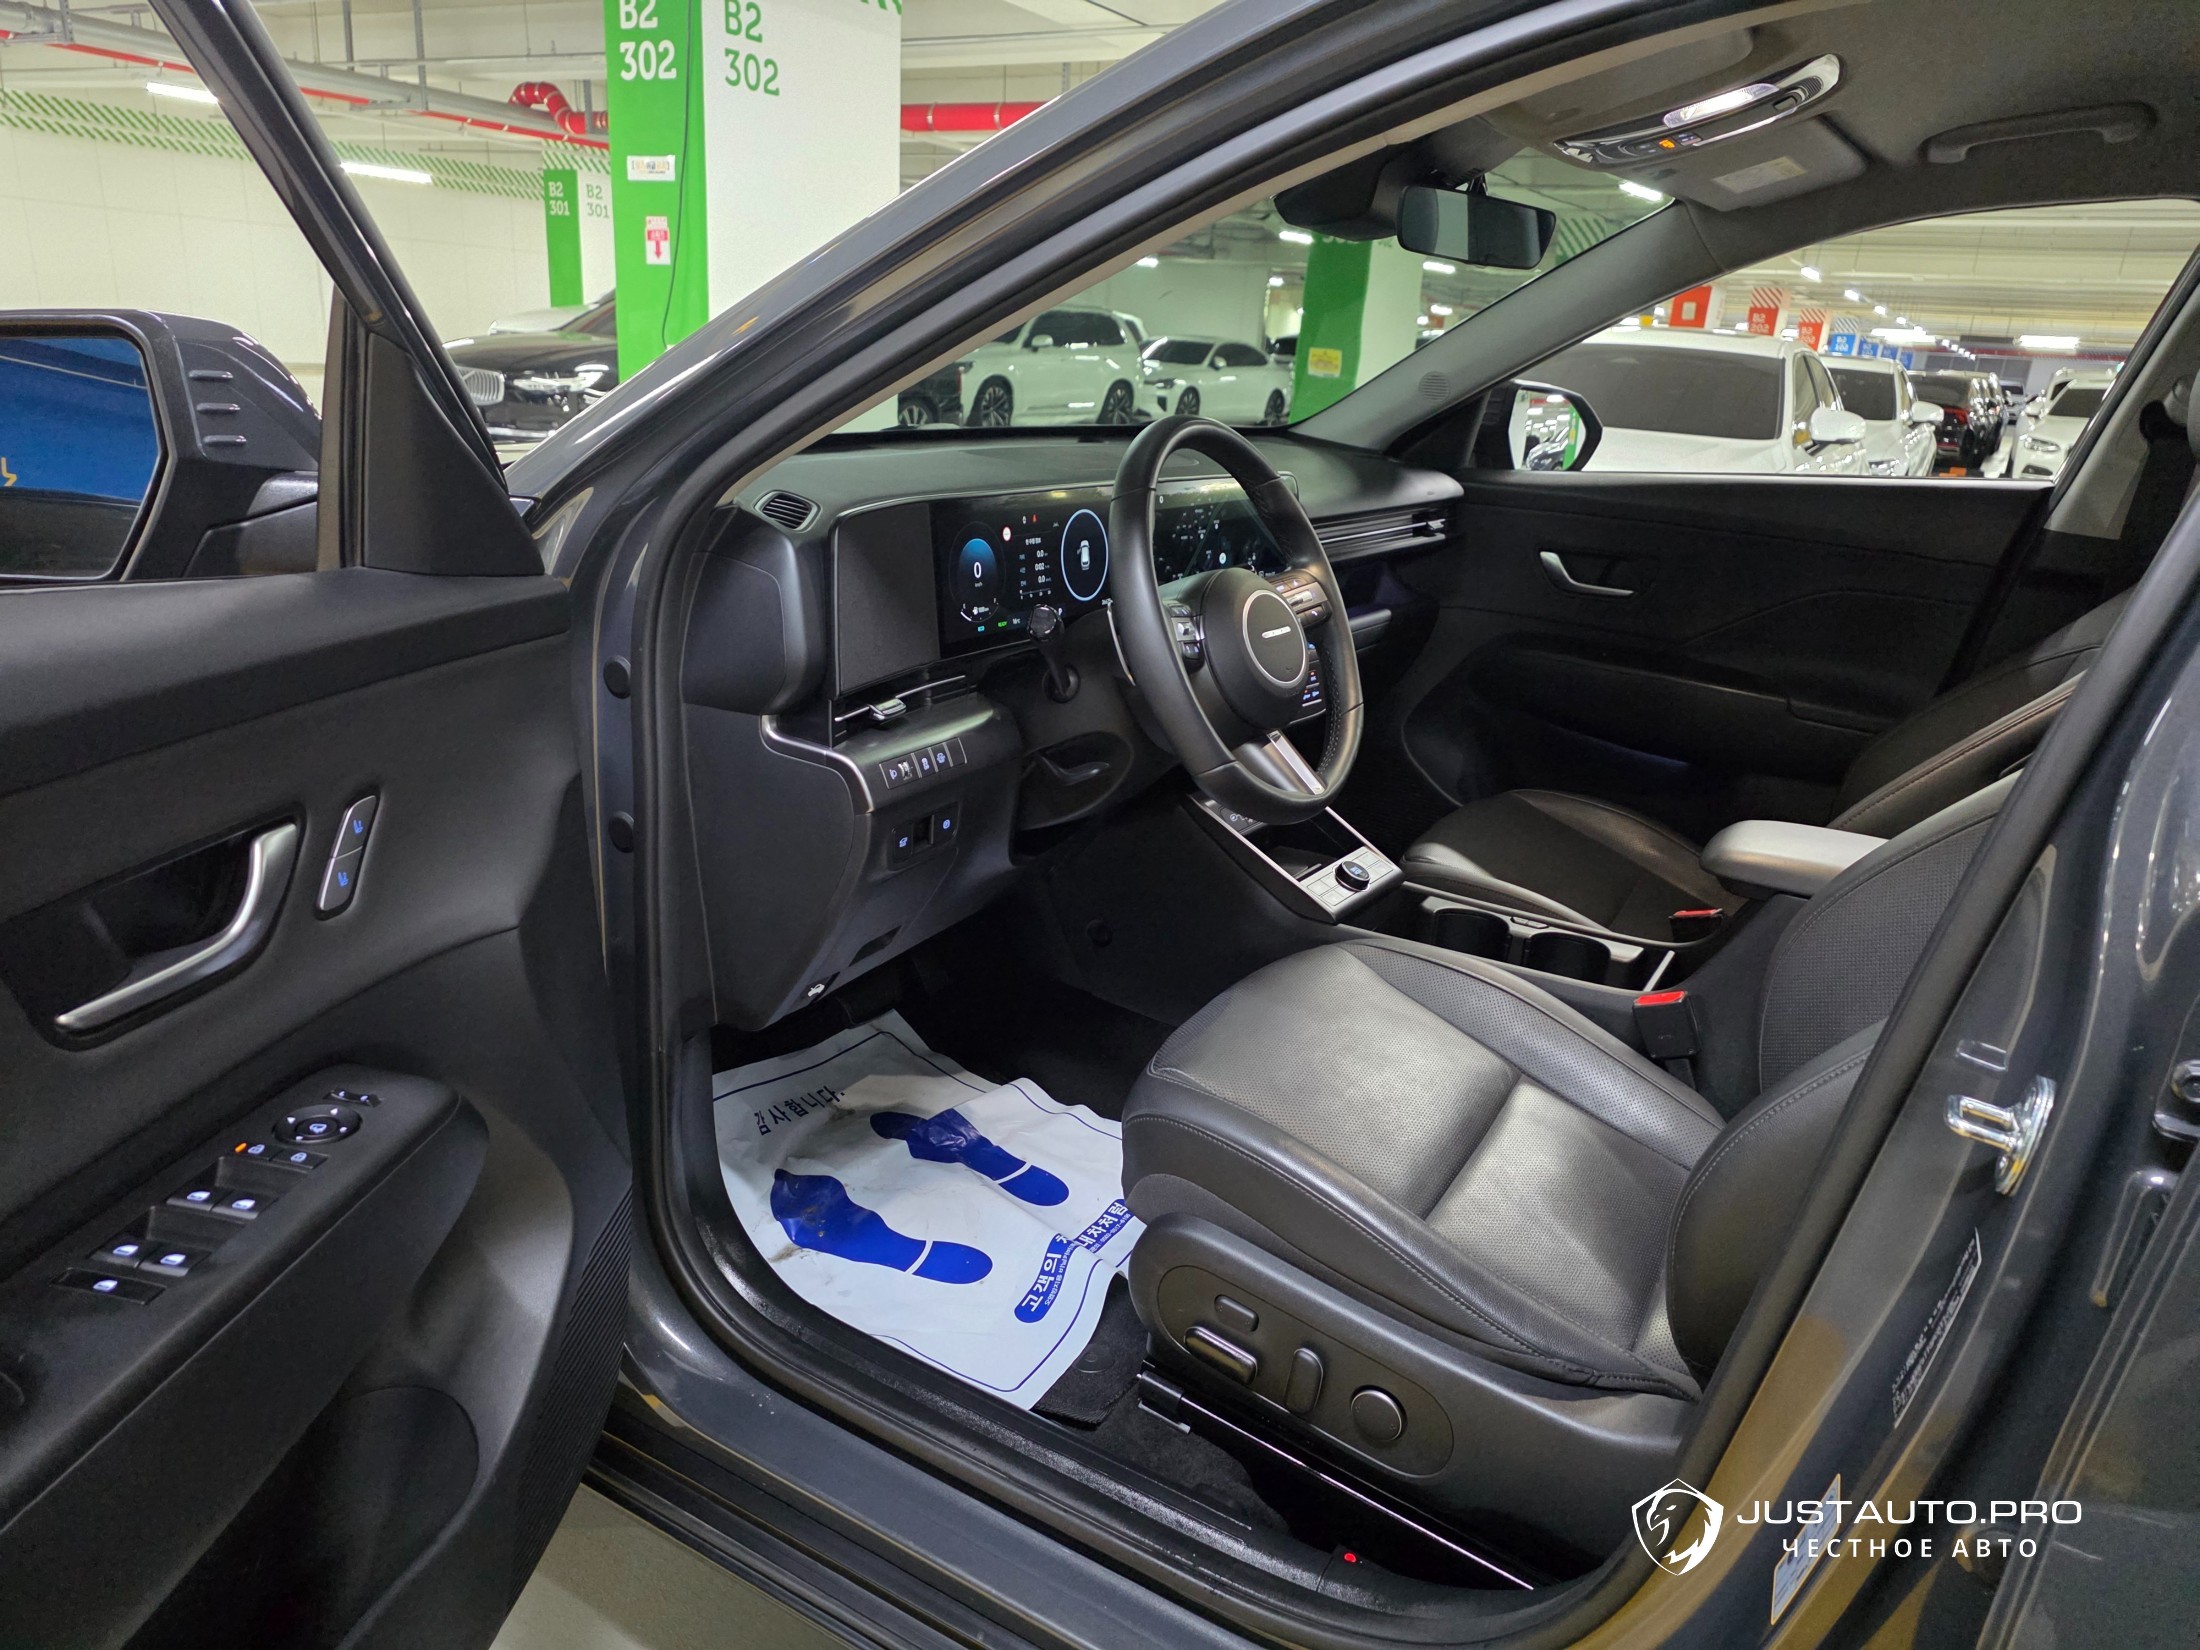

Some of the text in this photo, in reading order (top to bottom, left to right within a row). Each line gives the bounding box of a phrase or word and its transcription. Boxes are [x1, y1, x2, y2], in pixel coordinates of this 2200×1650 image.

[620, 0, 658, 29] B2
[725, 0, 763, 43] B2
[619, 40, 677, 81] 302
[725, 48, 780, 96] 302
[548, 181, 564, 197] B2
[586, 184, 603, 200] B2
[549, 200, 571, 216] 301
[586, 202, 610, 219] 301
[973, 561, 982, 579] 0
[754, 1085, 845, 1136] 감사합니다.
[1021, 1252, 1062, 1312] 고객의
